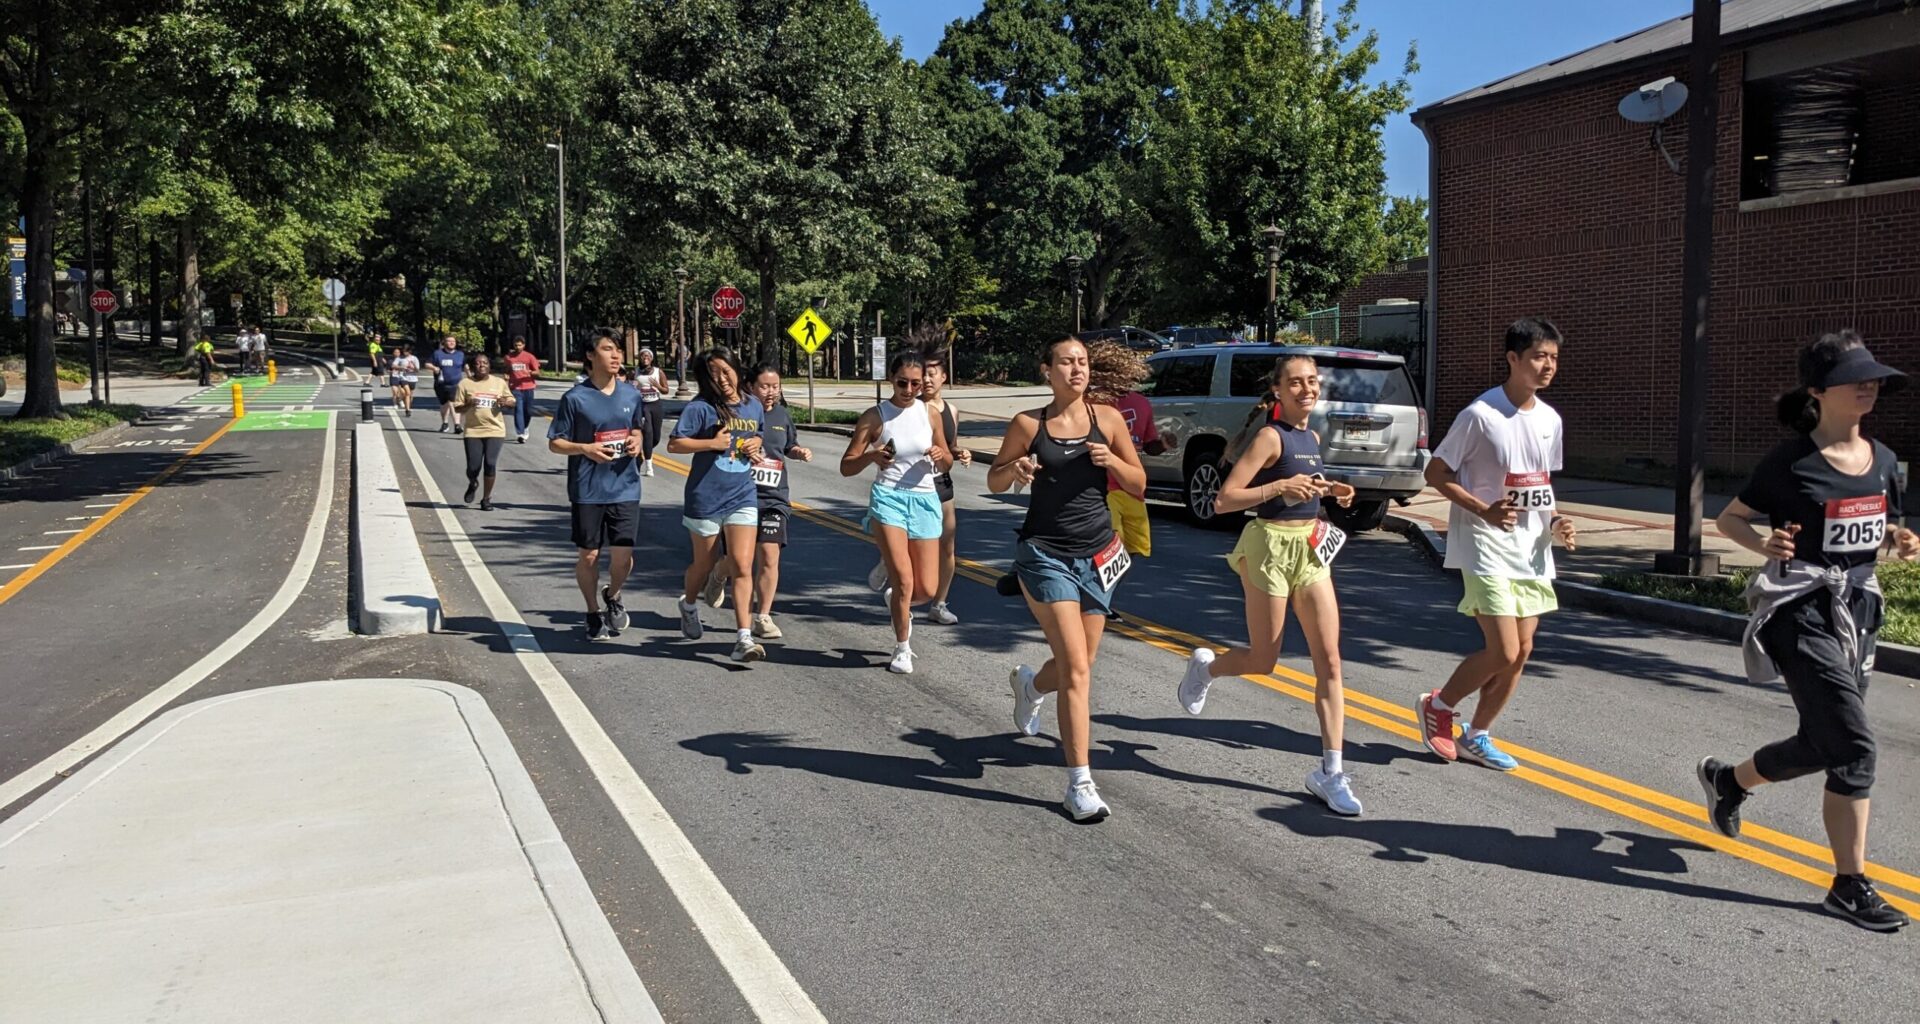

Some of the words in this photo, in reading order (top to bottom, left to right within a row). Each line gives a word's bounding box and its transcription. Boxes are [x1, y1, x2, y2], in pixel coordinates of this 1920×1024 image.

[15, 276, 23, 300] KLAUS
[92, 297, 115, 306] STOP
[715, 297, 743, 309] STOP
[115, 439, 185, 447] SLOW
[751, 469, 779, 484] 2017
[1507, 489, 1552, 507] 2155
[1862, 502, 1882, 511] RESULT
[1829, 519, 1884, 546] 2053
